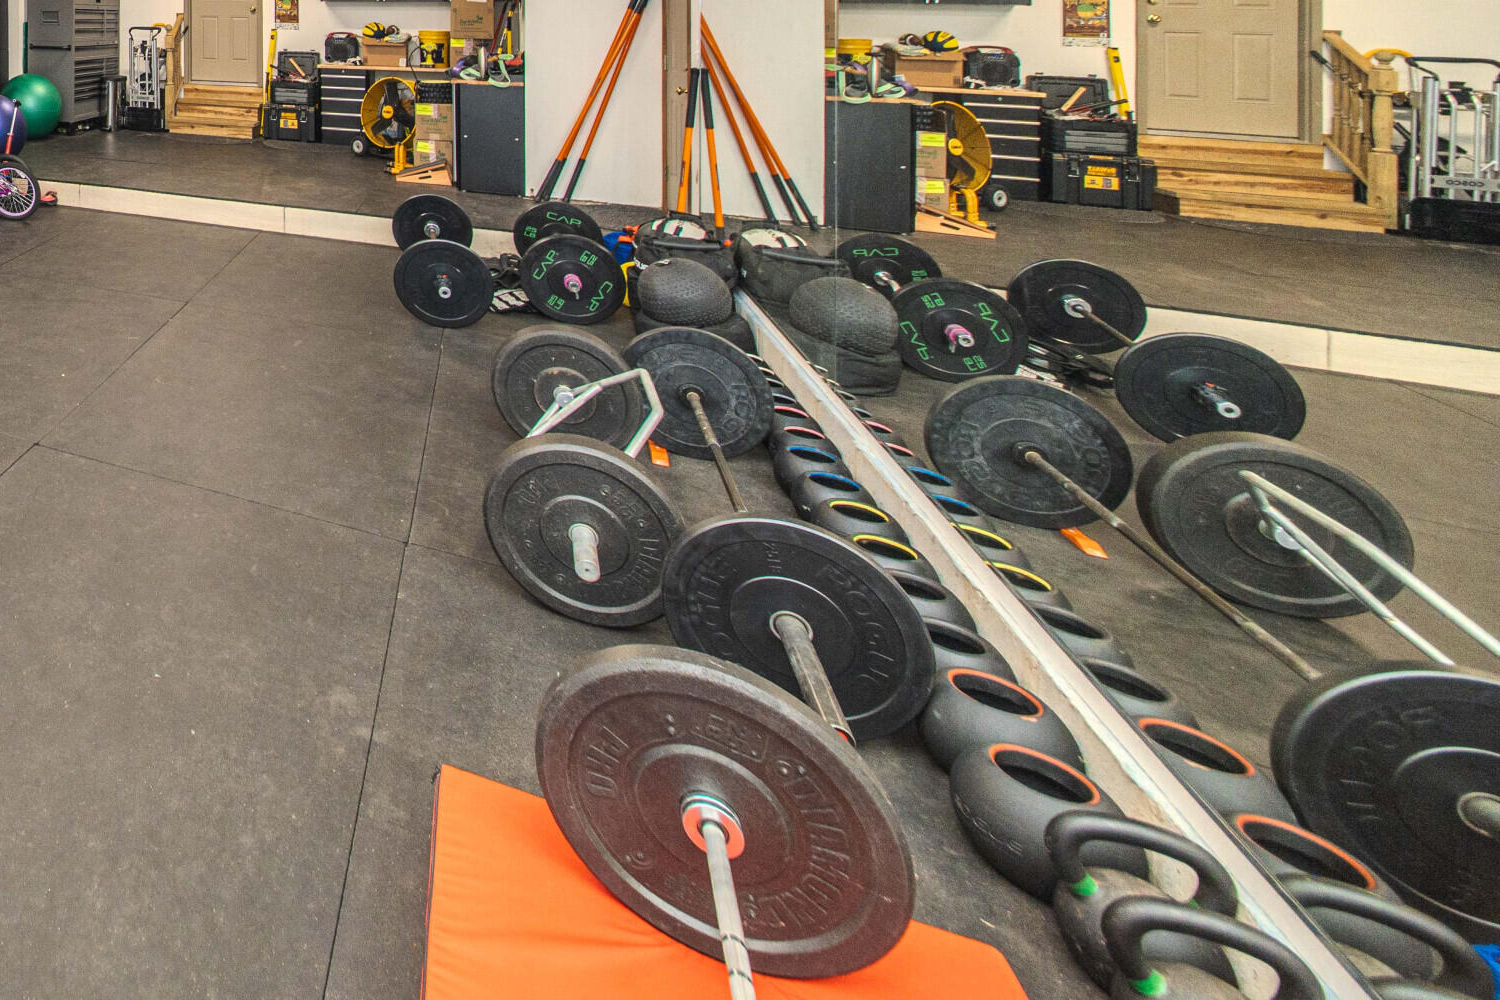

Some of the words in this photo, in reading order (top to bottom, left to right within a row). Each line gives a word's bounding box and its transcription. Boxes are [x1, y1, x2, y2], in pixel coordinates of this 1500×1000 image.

[546, 211, 582, 226] CAP
[532, 249, 557, 280] CAP
[589, 281, 613, 312] CAP
